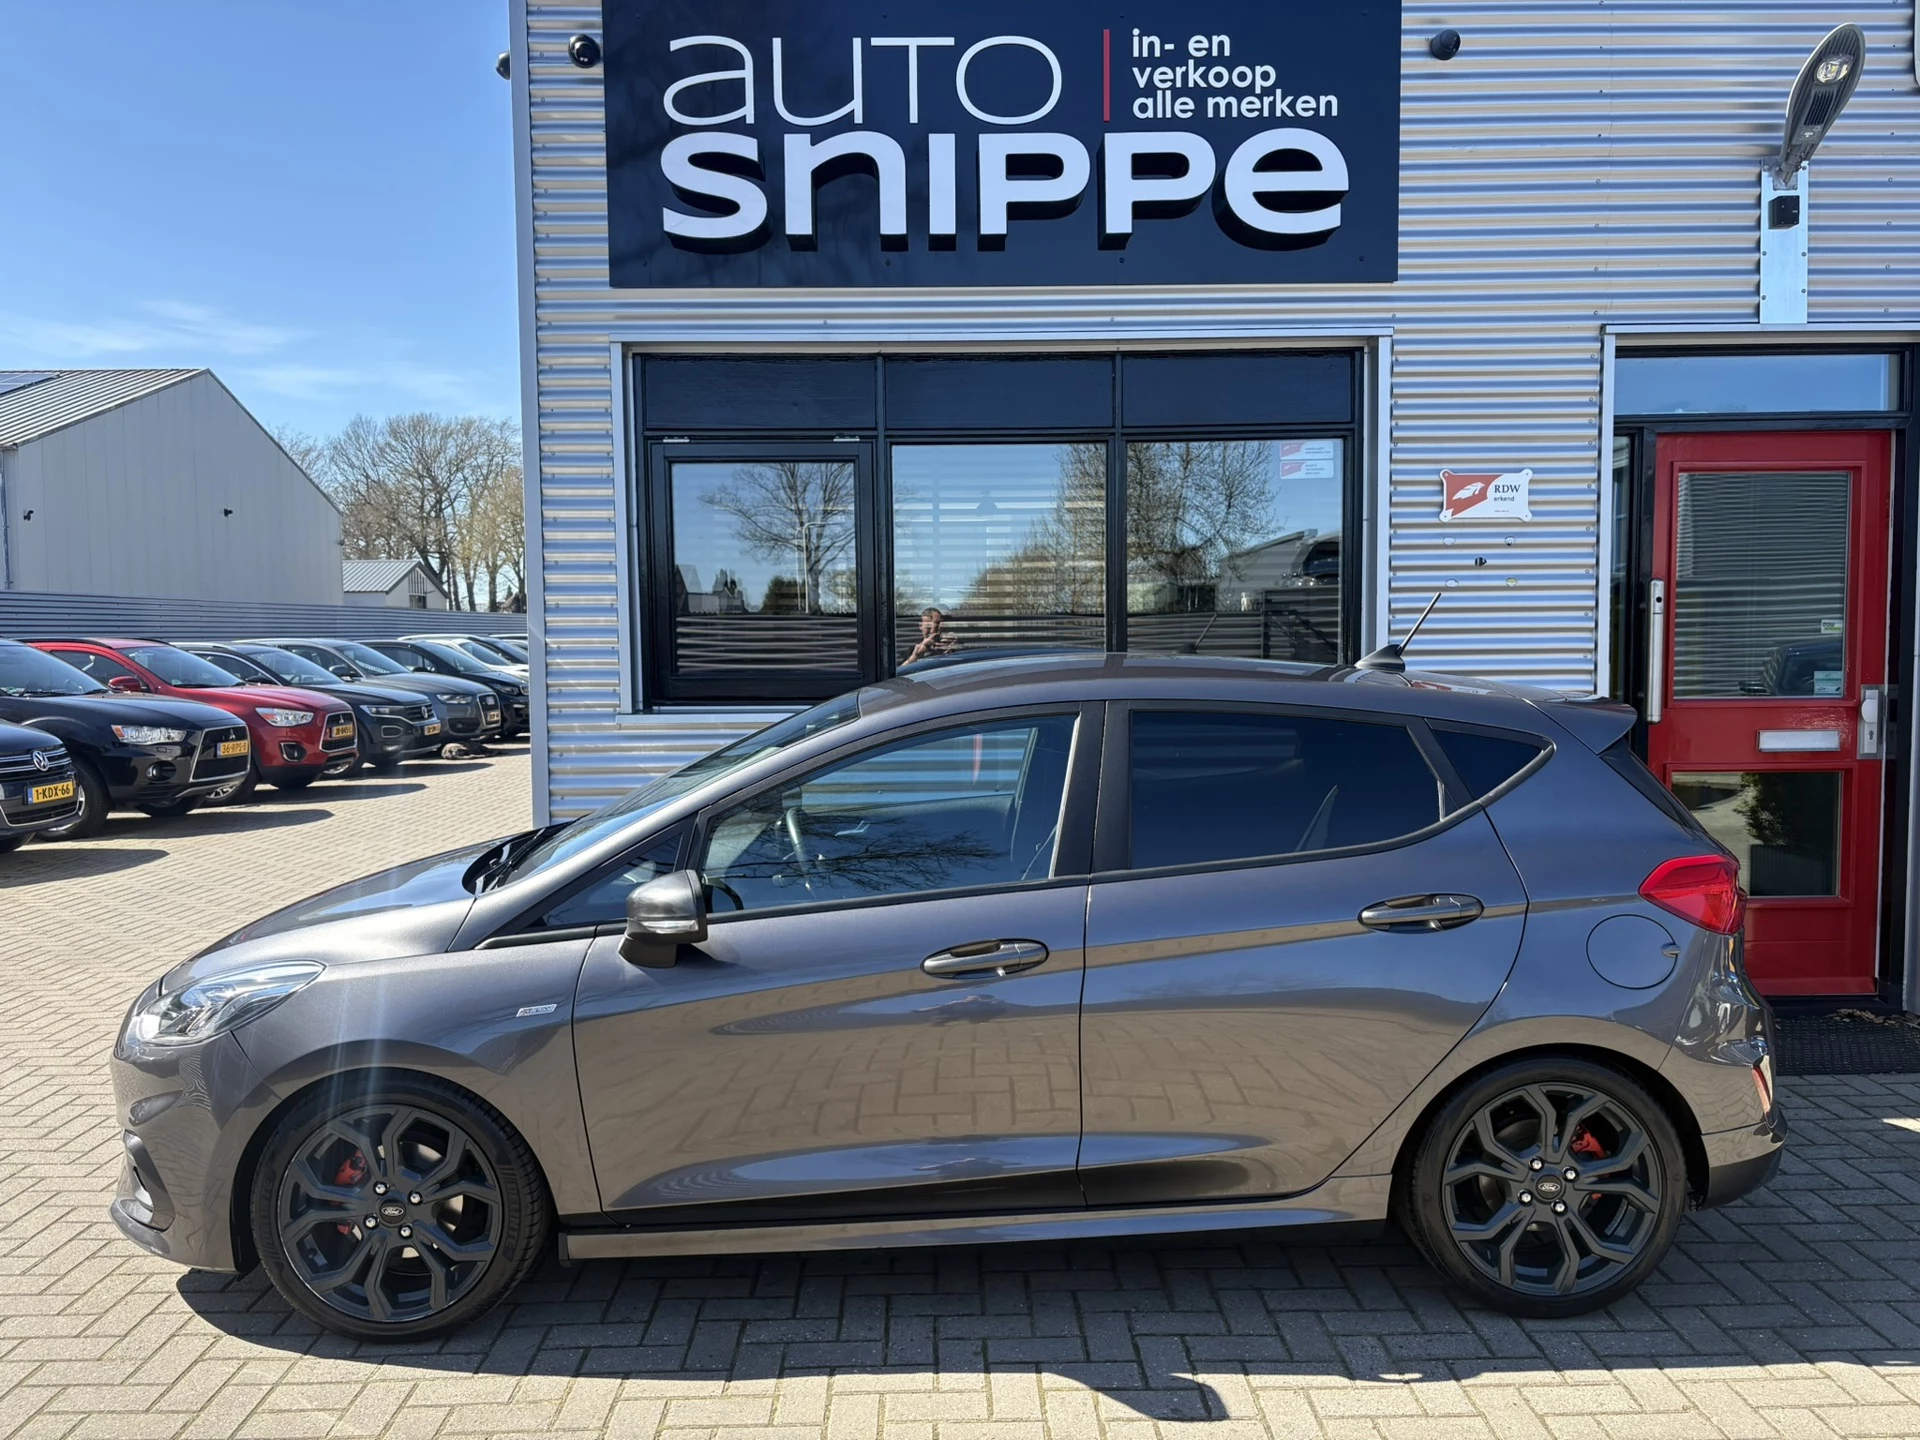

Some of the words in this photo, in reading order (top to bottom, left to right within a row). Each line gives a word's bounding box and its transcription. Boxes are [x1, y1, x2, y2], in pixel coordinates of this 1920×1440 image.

[1132, 28, 1175, 57] in-
[1188, 34, 1230, 57] en
[1132, 59, 1276, 94] verkoop
[1132, 90, 1195, 119] alle
[1207, 88, 1338, 118] merken
[1494, 484, 1521, 493] RDW
[35, 783, 71, 801] 1-KDX-66
